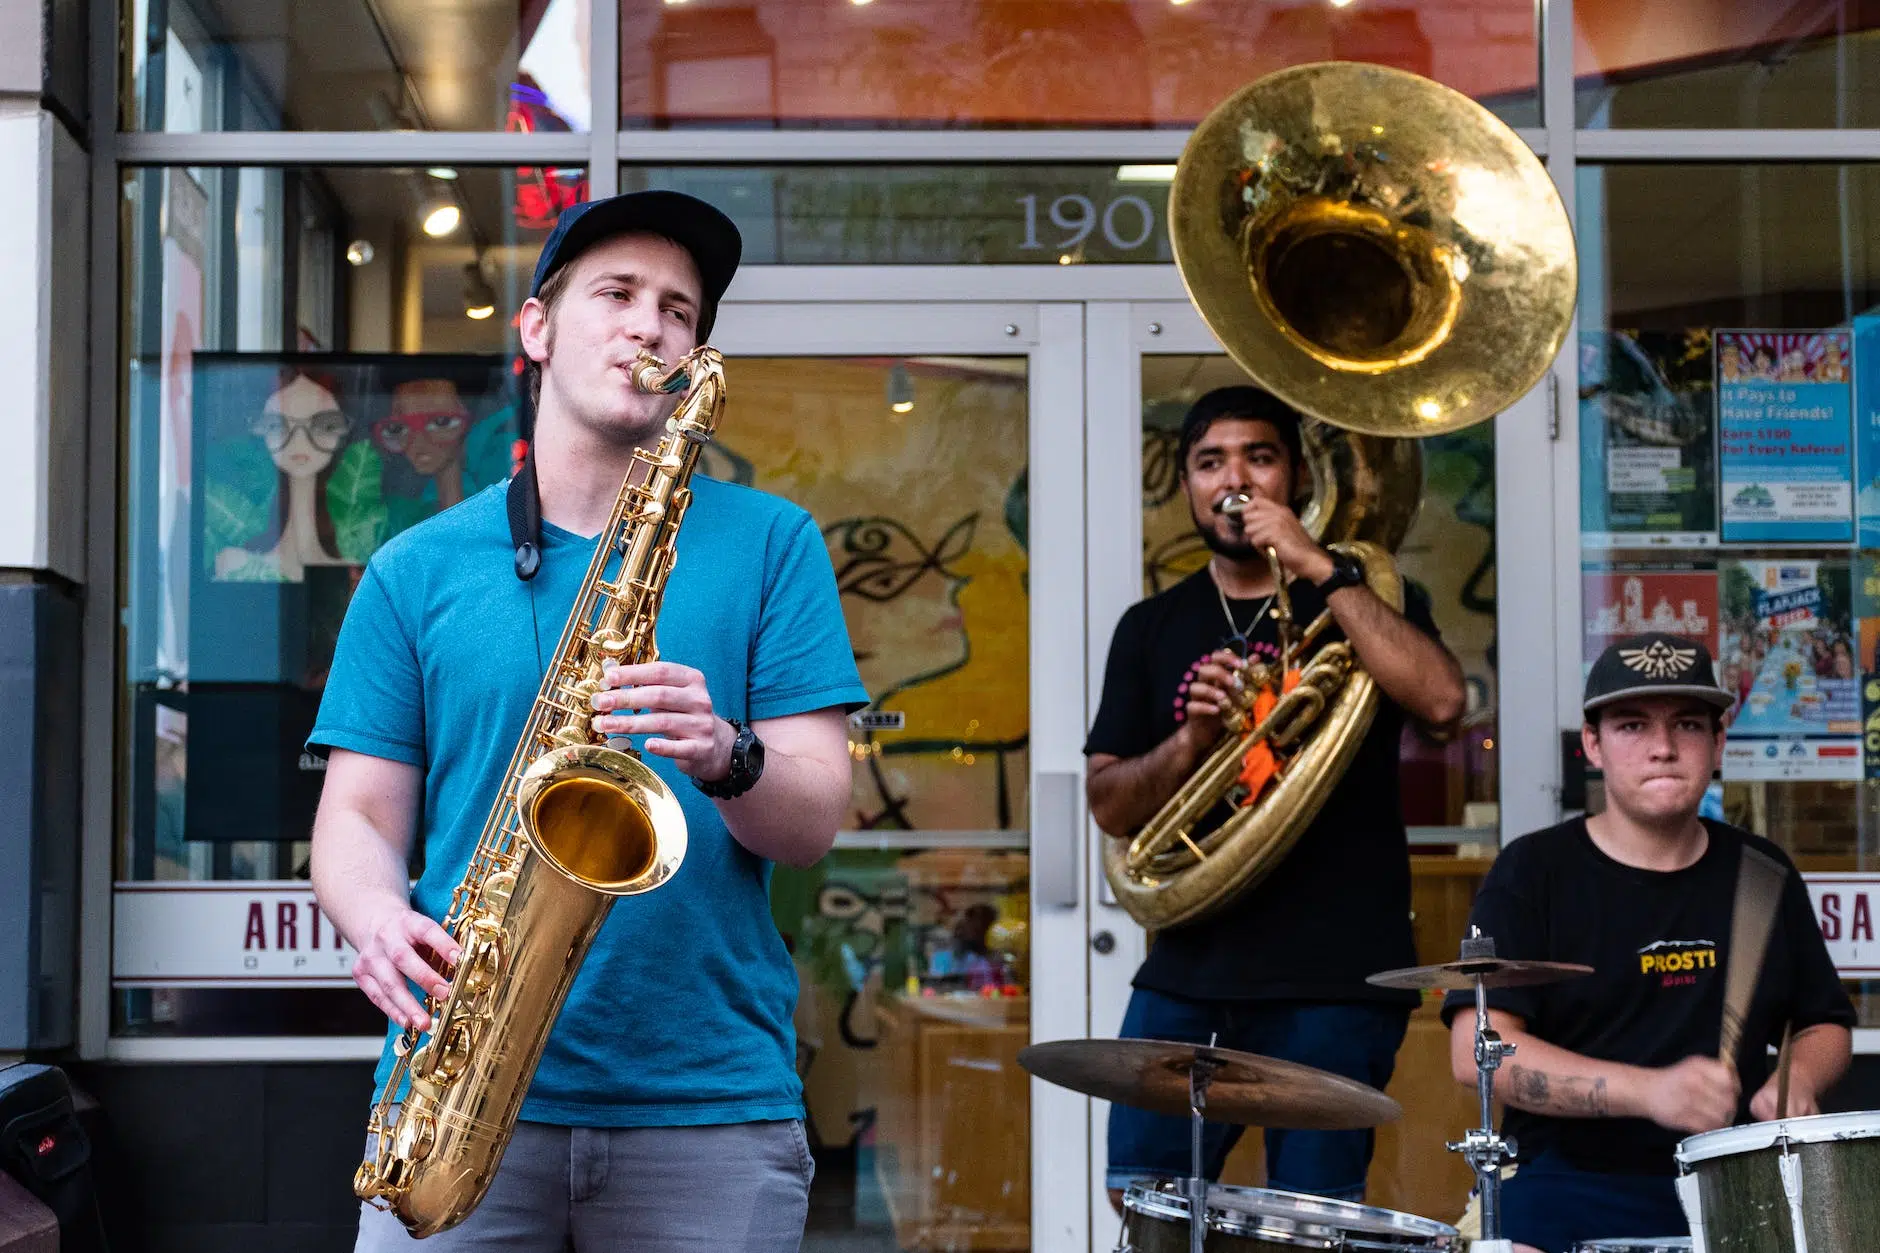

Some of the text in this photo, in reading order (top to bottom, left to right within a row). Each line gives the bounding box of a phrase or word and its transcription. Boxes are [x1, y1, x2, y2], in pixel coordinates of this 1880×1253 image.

[1015, 193, 1155, 250] 190
[1721, 387, 1797, 404] It Pays to
[1721, 405, 1834, 420] Have Friends!
[1721, 428, 1793, 440] Earn $100
[1748, 443, 1786, 456] Every
[1790, 442, 1846, 455] Referral
[1640, 949, 1717, 974] PROST!
